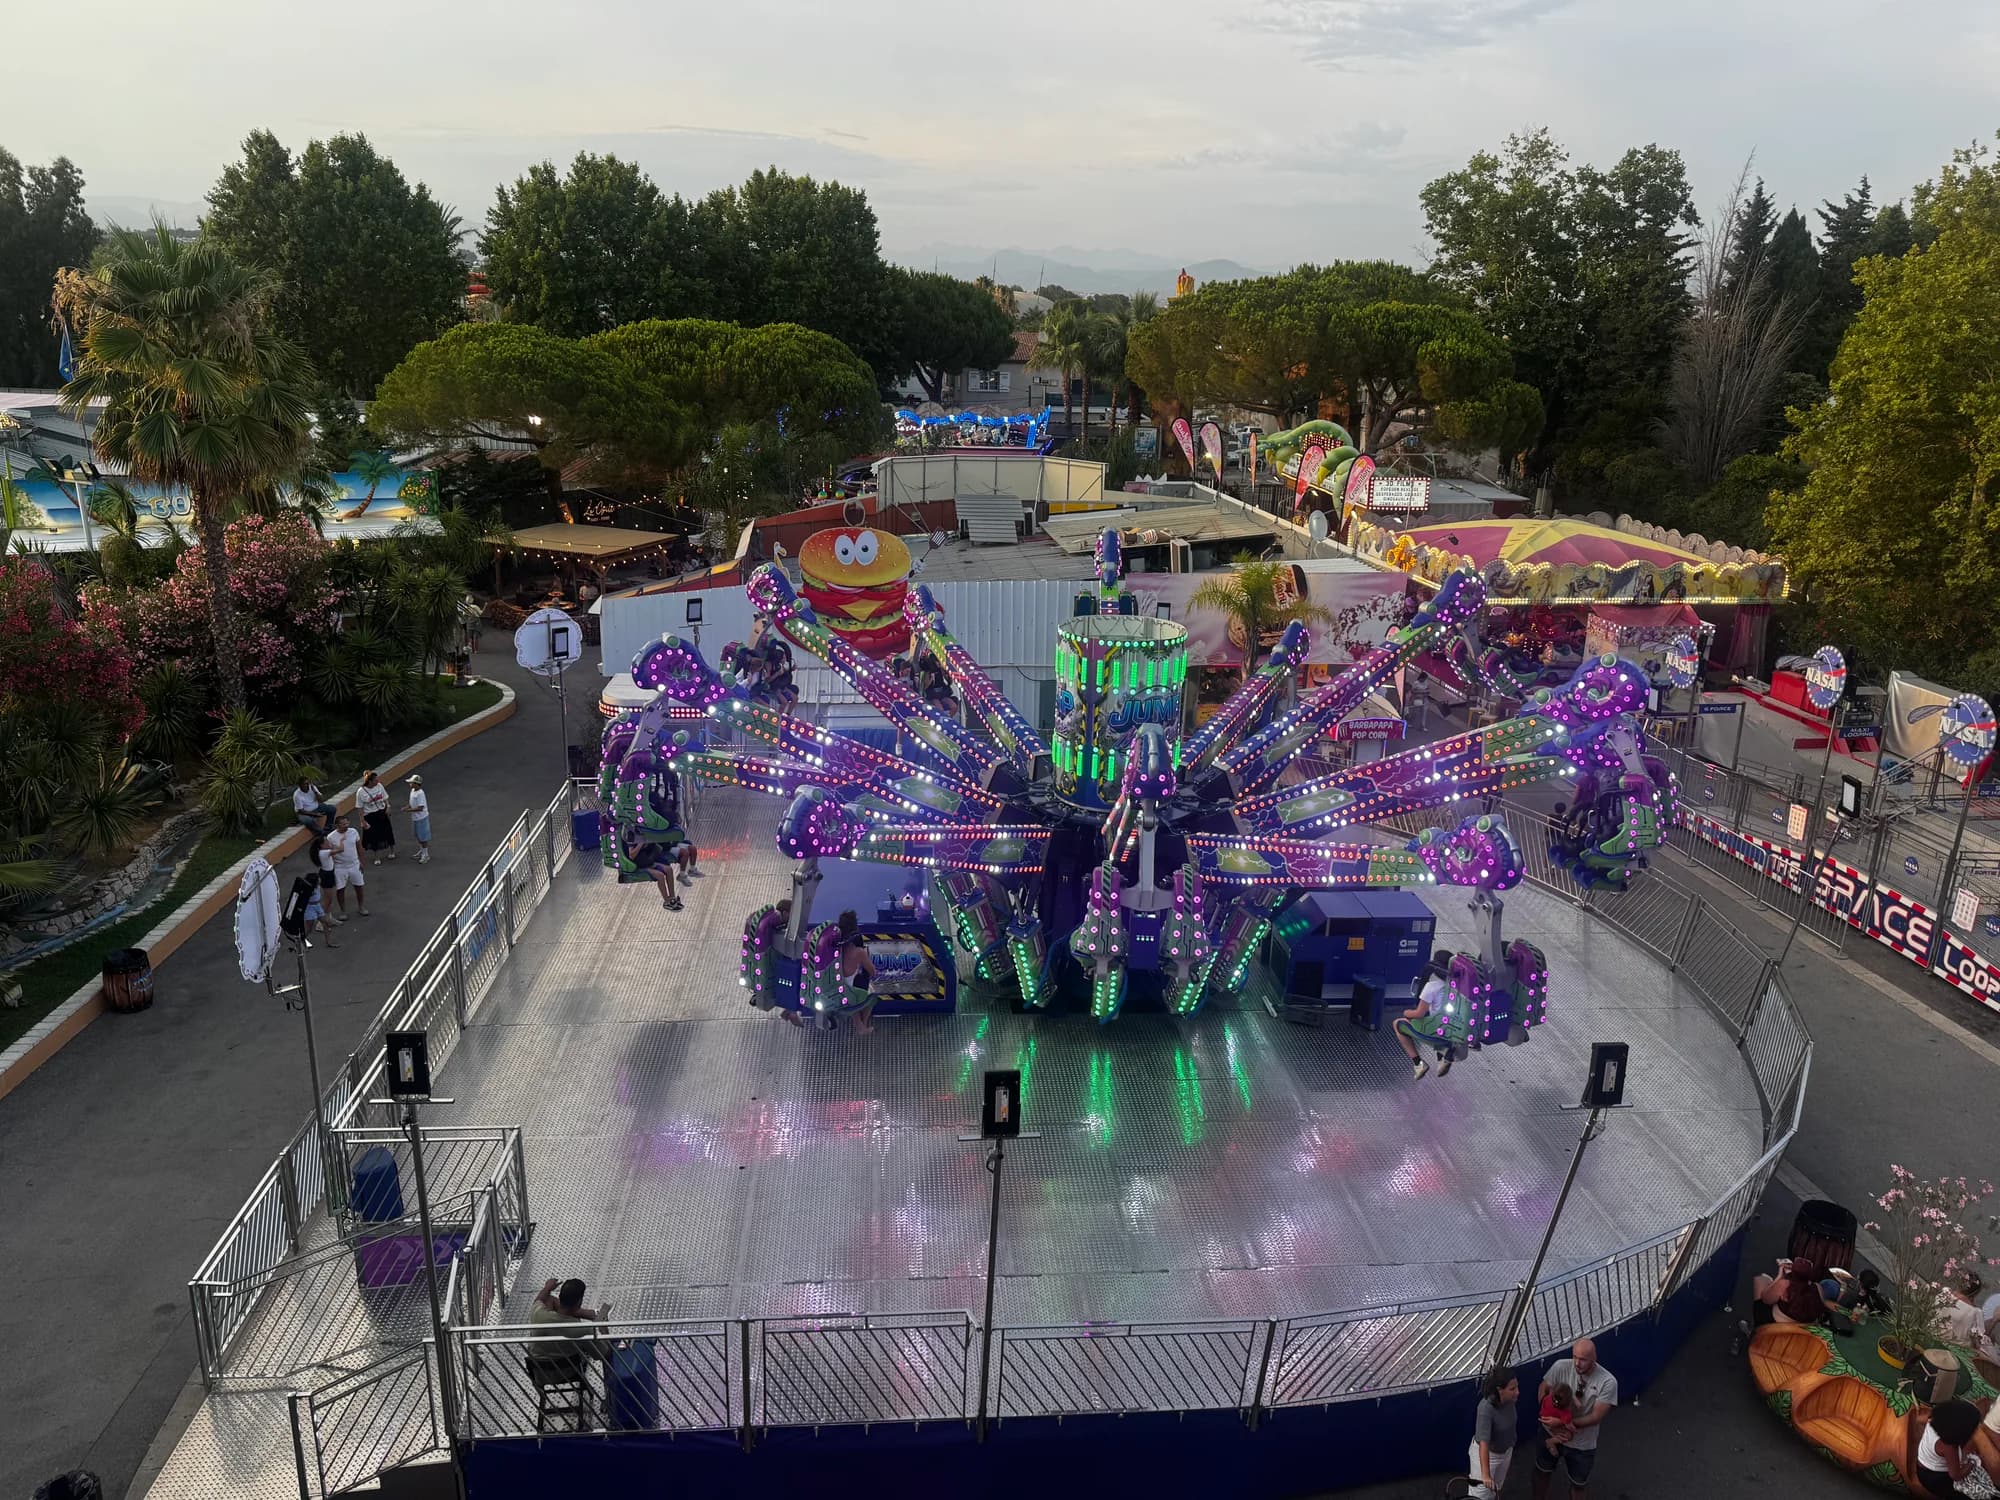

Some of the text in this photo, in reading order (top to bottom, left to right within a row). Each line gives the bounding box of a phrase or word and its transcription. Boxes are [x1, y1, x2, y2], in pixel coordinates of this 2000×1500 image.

[1665, 652, 1693, 674] NASA
[1805, 667, 1838, 690] NASA
[1349, 721, 1393, 729] BARBAPAPA
[1352, 731, 1388, 739] POP CORN
[1939, 717, 1986, 748] NASA
[1770, 853, 1801, 882] THE
[1814, 864, 1933, 954] SPACE
[1944, 944, 2000, 995] LOOP
[872, 953, 922, 970] UMP
